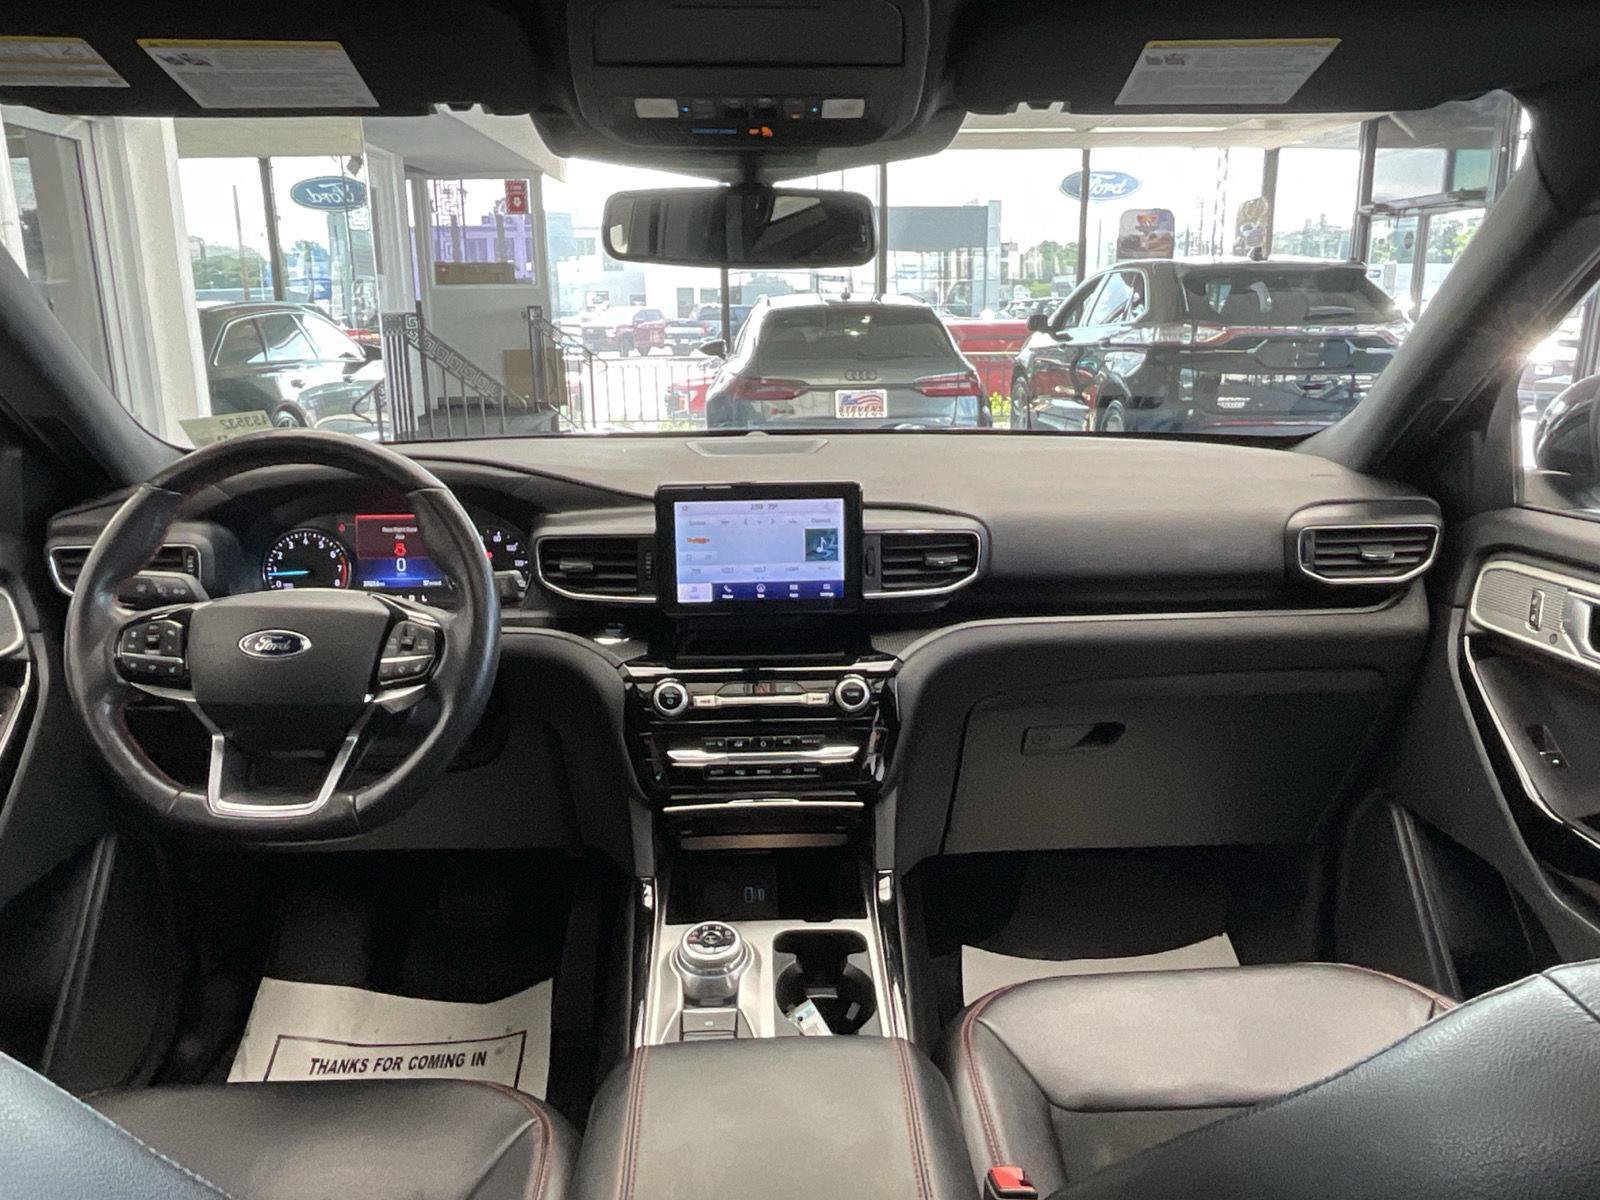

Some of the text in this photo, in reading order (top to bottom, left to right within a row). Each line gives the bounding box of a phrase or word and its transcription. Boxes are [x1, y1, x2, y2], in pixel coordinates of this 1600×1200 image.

[1081, 174, 1129, 195] Ford
[288, 540, 295, 550] 3
[318, 540, 325, 549] 5
[277, 551, 284, 560] 2
[329, 550, 337, 559] 6
[337, 564, 343, 573] 7
[396, 557, 407, 572] 0
[275, 580, 282, 588] 0
[254, 634, 292, 652] Ford
[309, 1051, 488, 1075] THANKS FOR COMING IN
